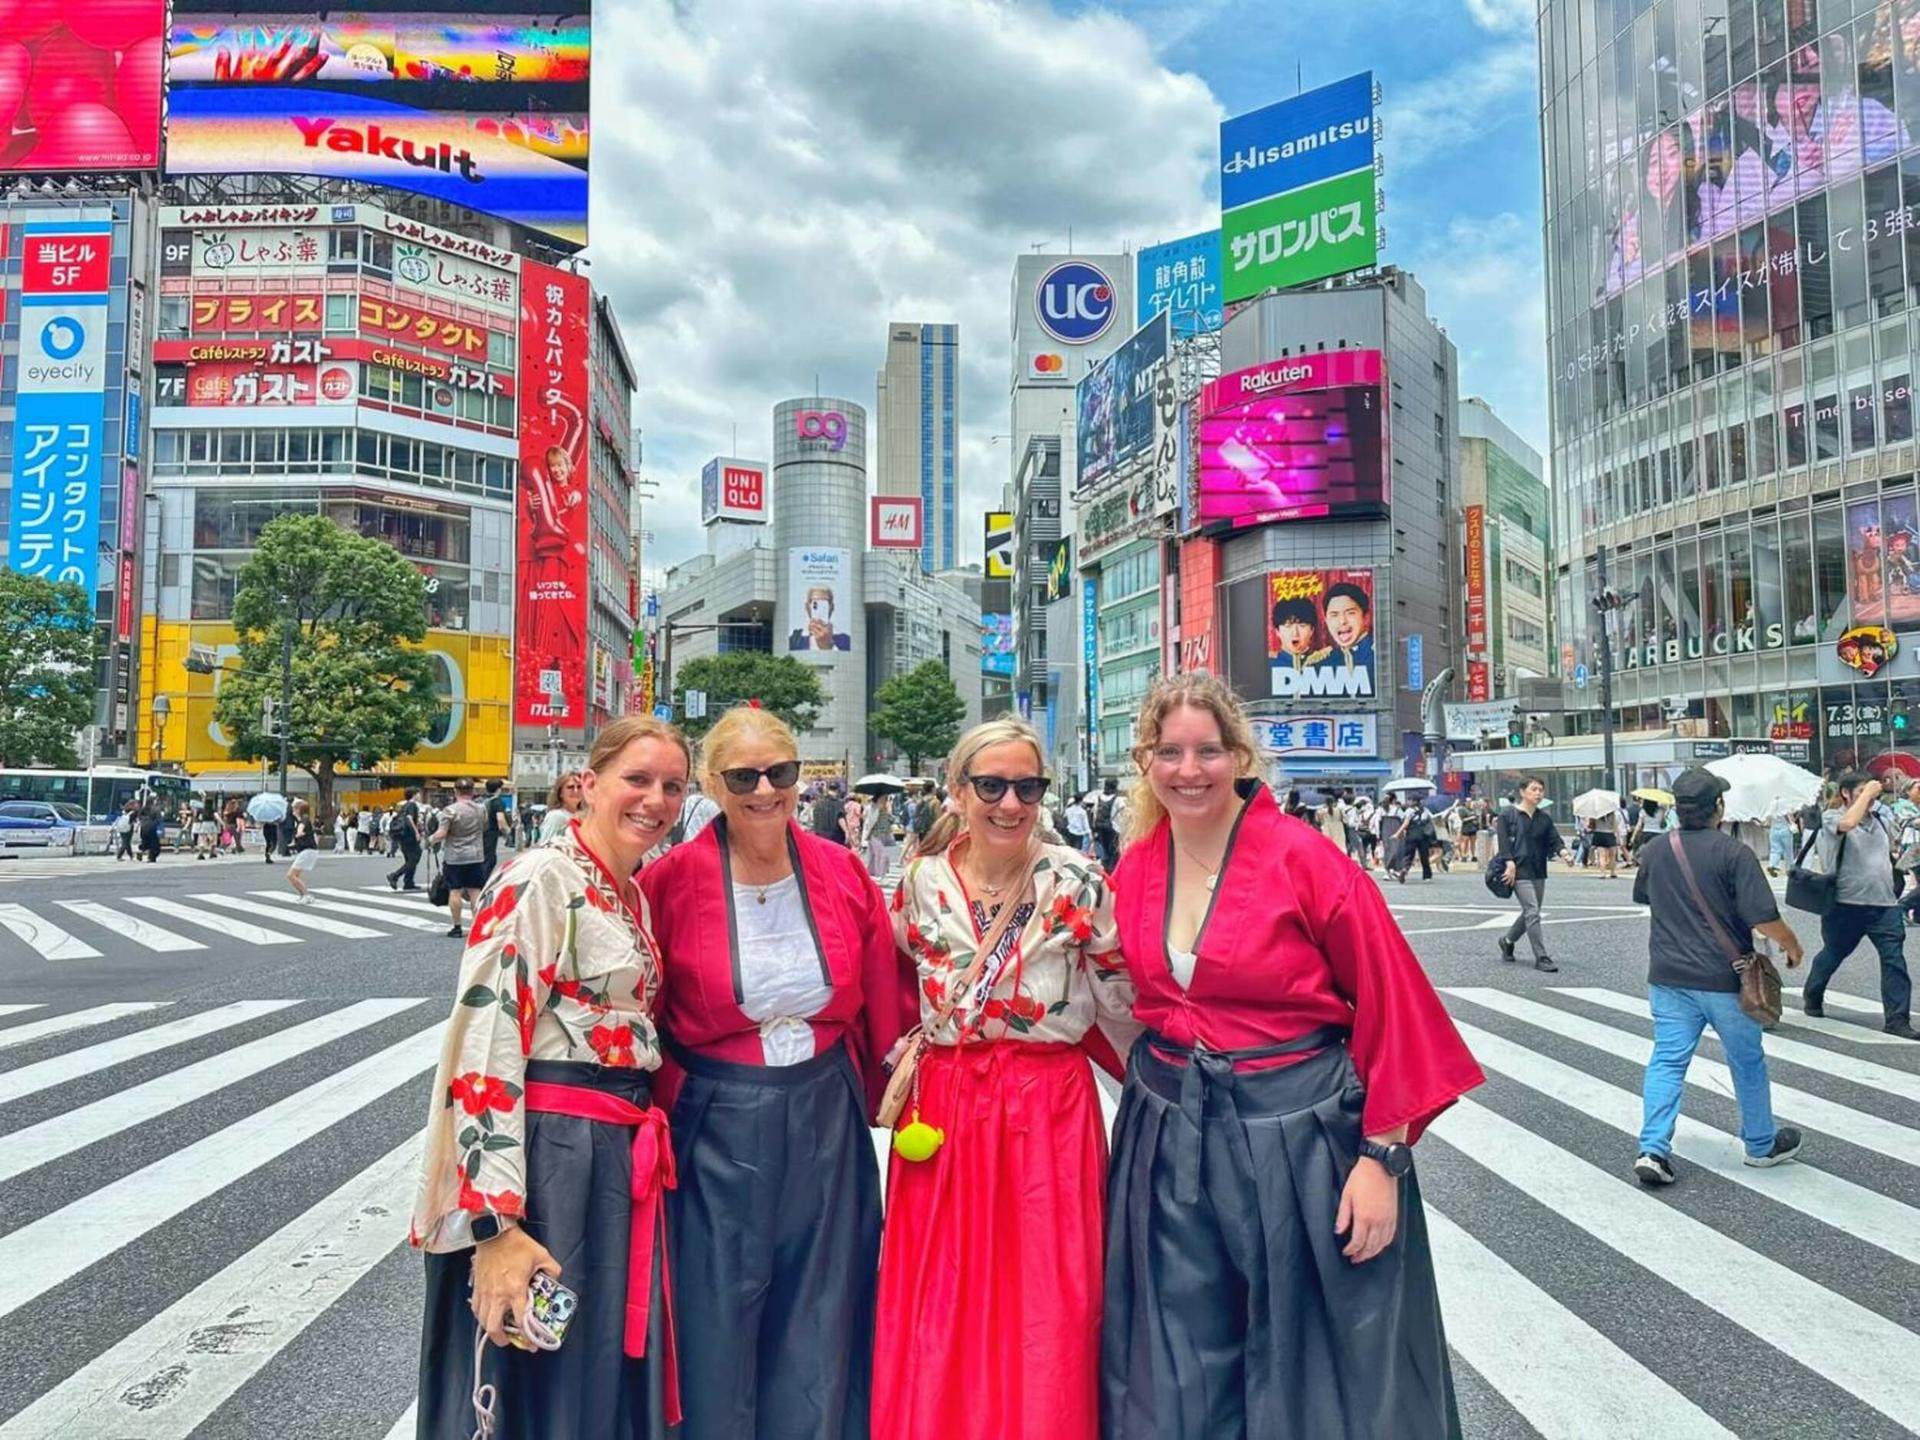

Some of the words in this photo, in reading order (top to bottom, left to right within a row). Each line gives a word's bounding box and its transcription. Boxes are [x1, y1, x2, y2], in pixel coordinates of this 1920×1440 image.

[291, 115, 486, 185] Yakult
[1222, 115, 1370, 174] Hisamitsu
[180, 207, 319, 224] しゃぶしゃぶバイキング
[240, 237, 318, 262] しゃぶ葉
[384, 214, 514, 266] しゃぶしゃぶバイキング
[1231, 200, 1365, 272] サロンパス
[38, 242, 97, 263] 当ビル
[165, 244, 190, 262] 9F
[51, 266, 81, 286] 5F
[437, 260, 512, 302] しゃぶ葉
[1155, 254, 1206, 291] 龍角散
[194, 298, 320, 325] プライス
[1045, 282, 1109, 321] UC
[360, 299, 484, 352] コンタクト
[270, 340, 332, 364] ガスト
[28, 363, 94, 384] eyecity
[159, 378, 186, 397] 7F
[231, 371, 308, 403] ガスト
[449, 364, 504, 393] ガスト
[1240, 363, 1313, 393] Rakuten
[792, 409, 848, 452] 109
[1790, 404, 1840, 428] Tme
[1155, 365, 1178, 506] もんじゃ
[728, 473, 757, 489] UNI
[59, 424, 91, 586] コンタクトの
[728, 489, 758, 506] QLO
[537, 581, 567, 590] いつでも
[1597, 623, 1784, 671] TARBUCKS
[1271, 665, 1372, 697] DMM
[1774, 702, 1808, 724] トイ
[1773, 725, 1813, 737] ストーリー
